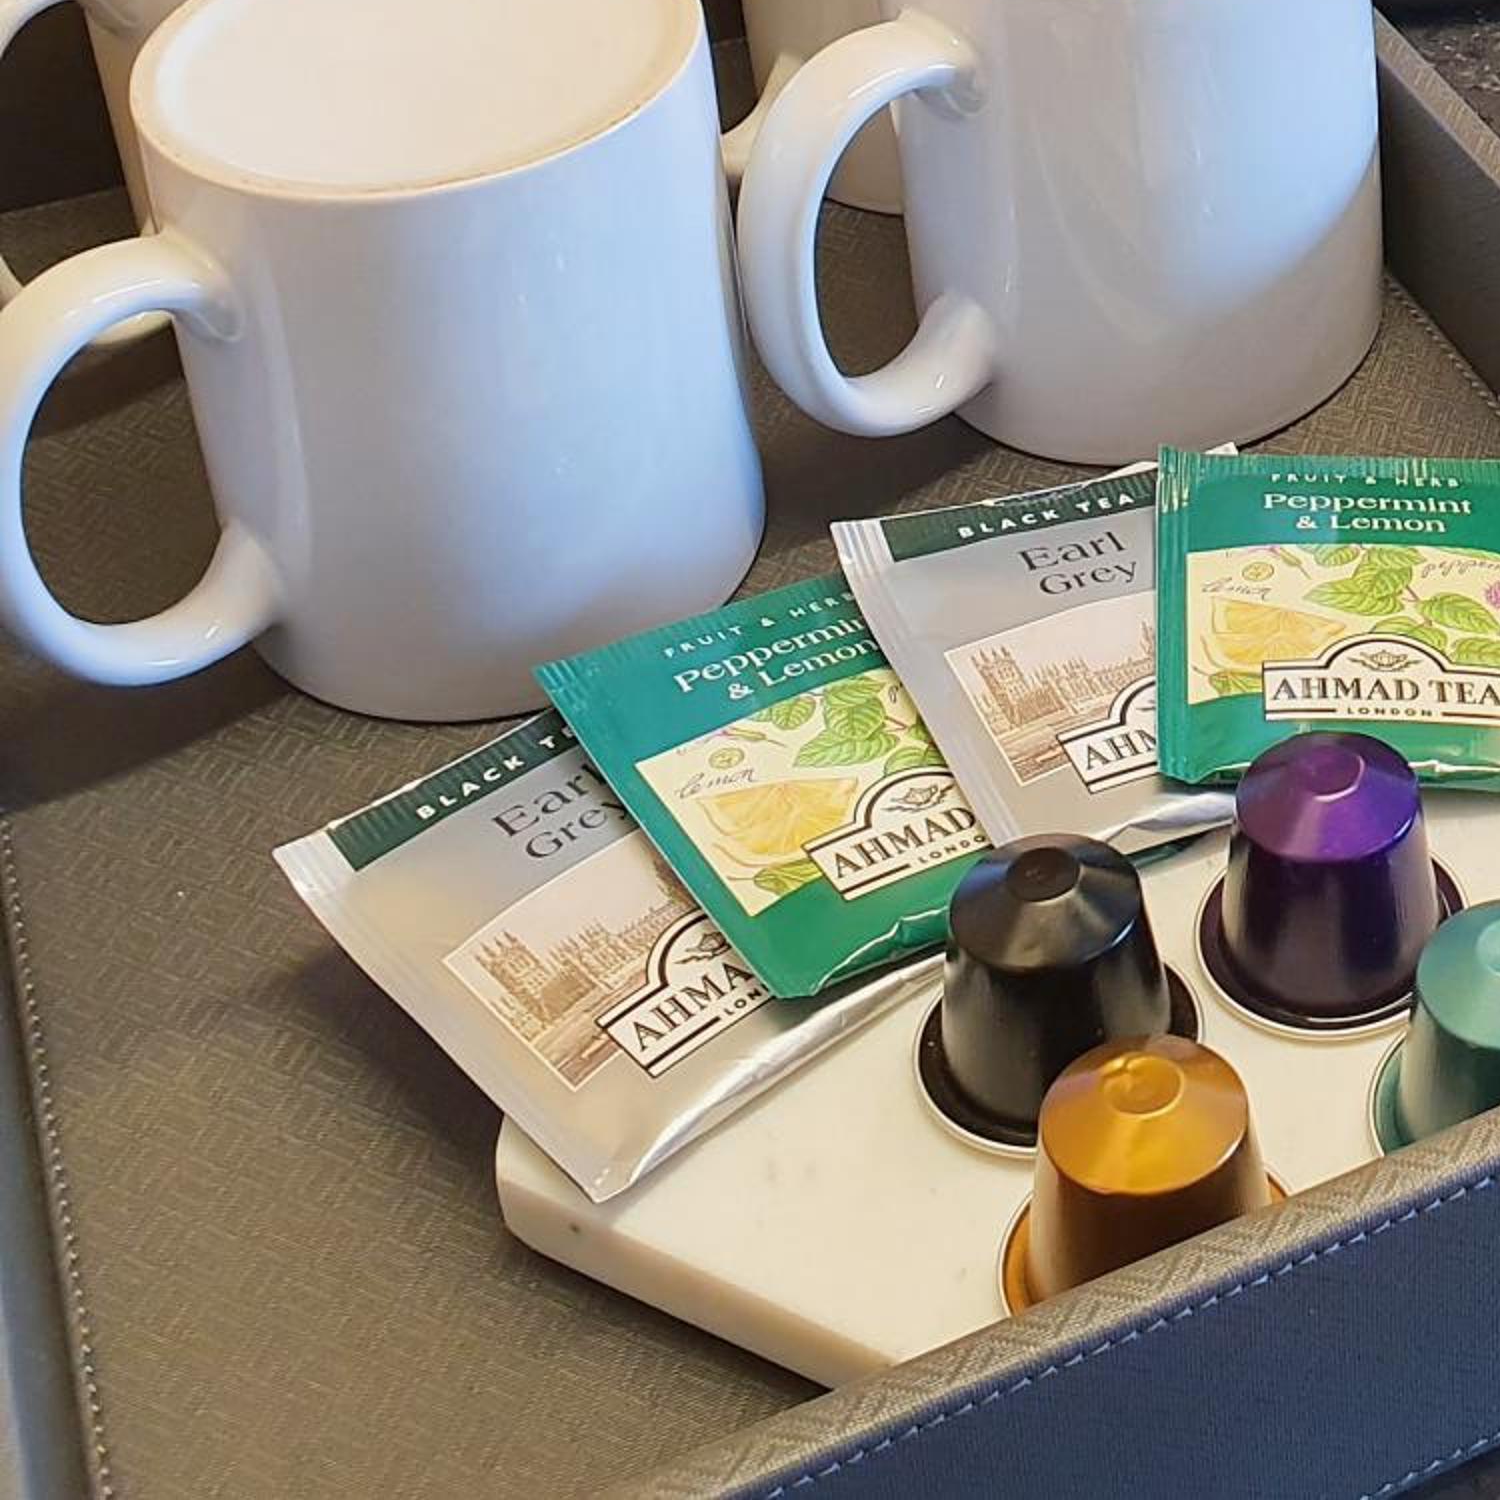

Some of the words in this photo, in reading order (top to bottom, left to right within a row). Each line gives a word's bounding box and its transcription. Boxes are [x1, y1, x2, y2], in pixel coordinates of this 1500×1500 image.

[1271, 473, 1347, 484] FRUIT
[1395, 477, 1460, 488] HERB
[957, 509, 1060, 539] BLACK
[1075, 493, 1134, 514] TEA
[1263, 492, 1473, 515] Peppermint
[1295, 515, 1318, 530] &
[1330, 514, 1448, 534] Lemon
[1019, 531, 1126, 571] Earl
[1039, 560, 1138, 595] Grey
[664, 625, 743, 658] FRUIT
[673, 618, 866, 693] Peppermi
[727, 683, 754, 700] &
[758, 638, 880, 687] Lemon
[1272, 677, 1420, 703] AHMAD
[1346, 706, 1433, 717] LONDON
[415, 754, 525, 820] BLACK
[491, 763, 608, 837] Earl
[833, 807, 977, 879] AHMAD
[918, 834, 987, 863] LONDO
[633, 963, 770, 1052] AHMA
[723, 988, 764, 1016] LON
